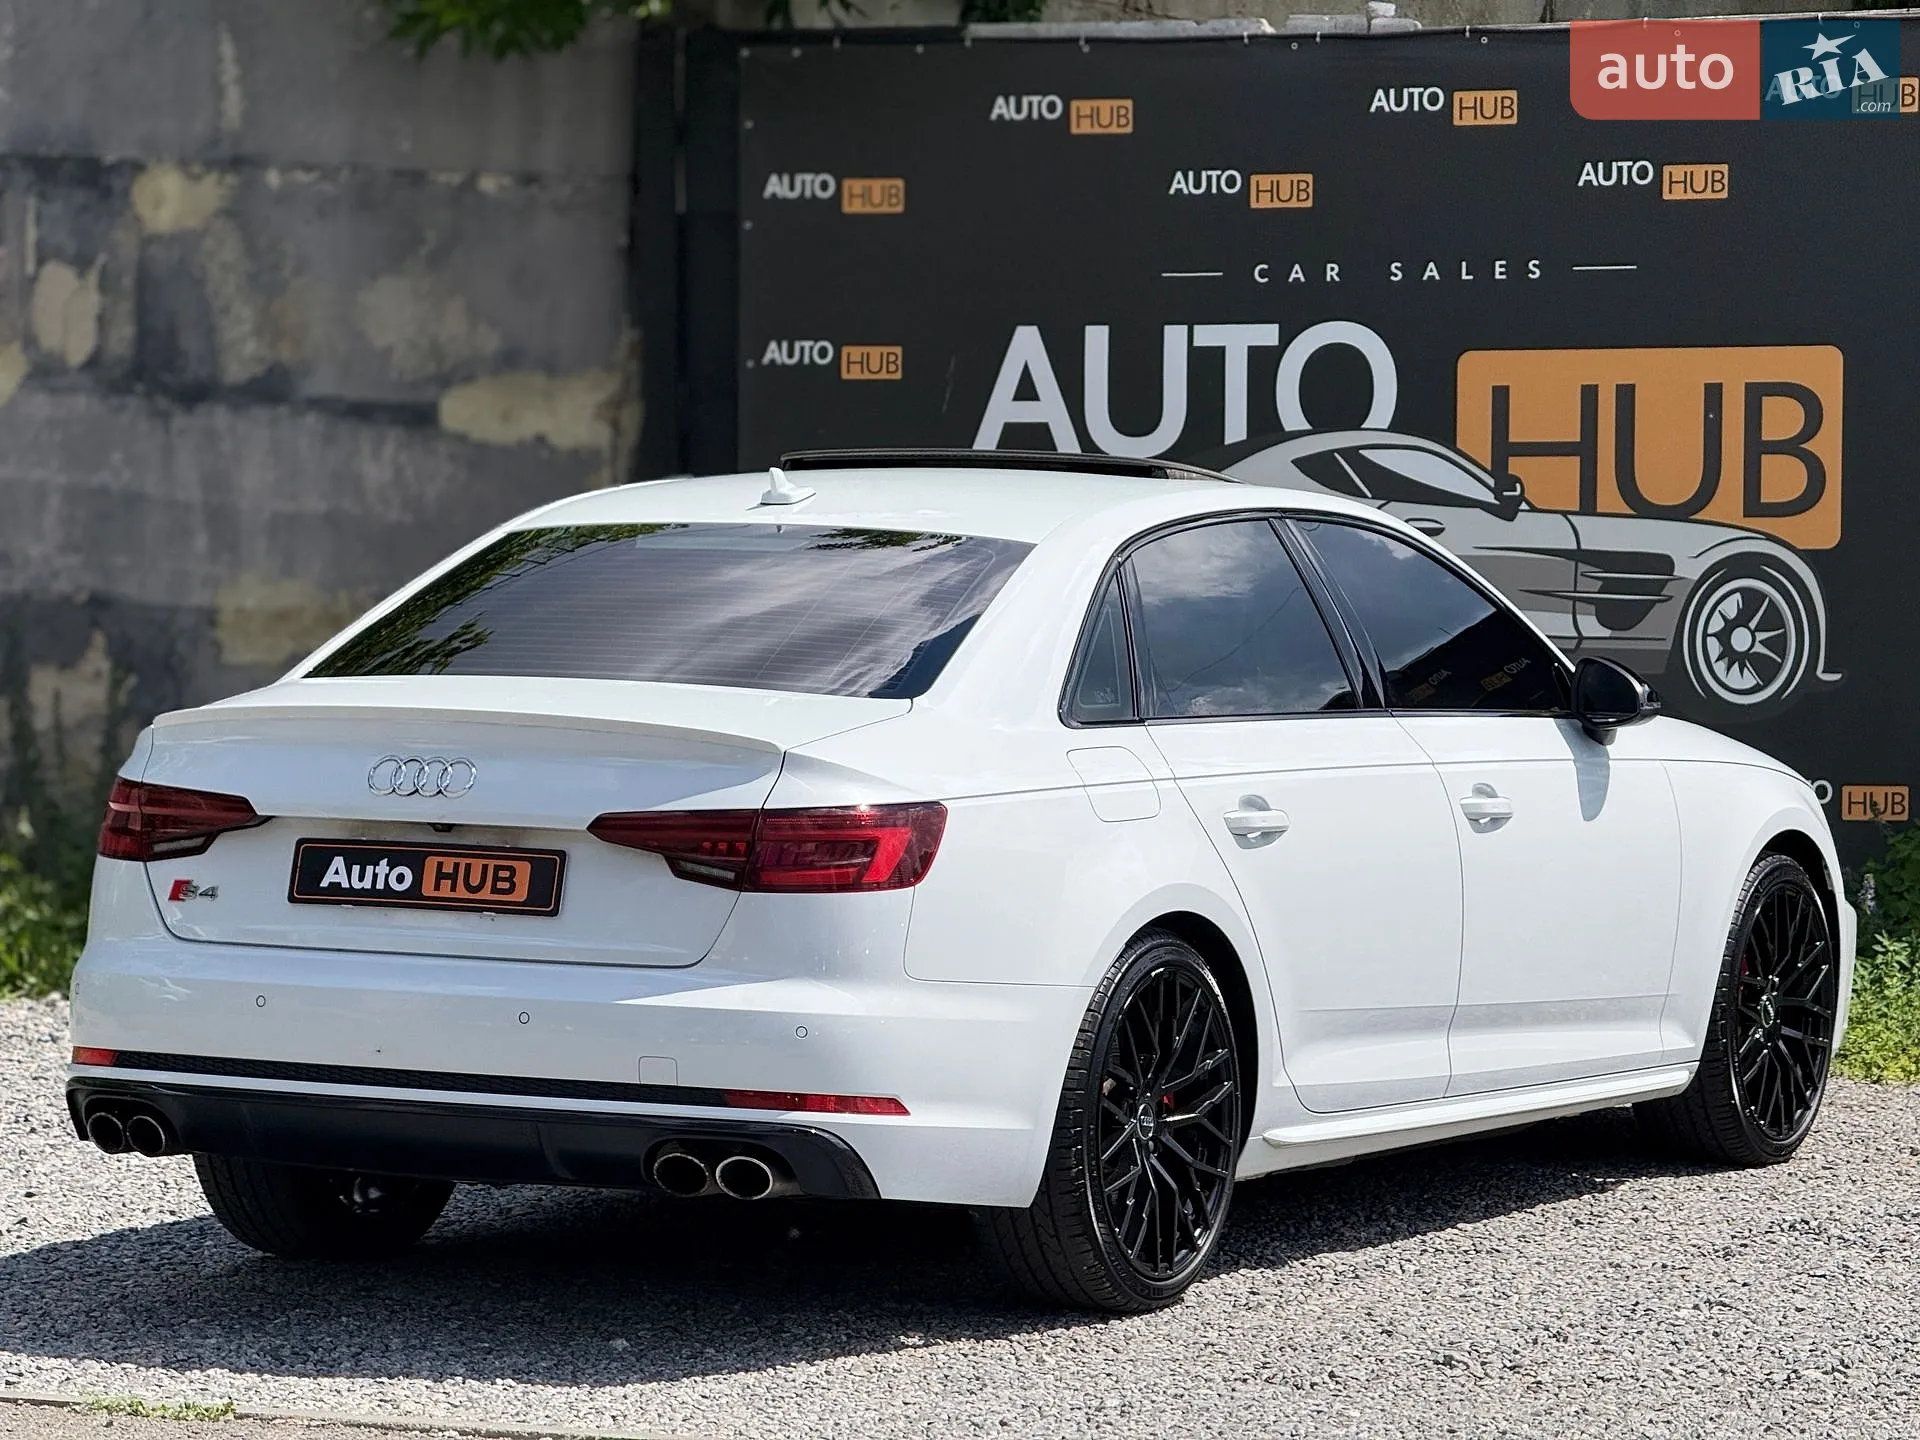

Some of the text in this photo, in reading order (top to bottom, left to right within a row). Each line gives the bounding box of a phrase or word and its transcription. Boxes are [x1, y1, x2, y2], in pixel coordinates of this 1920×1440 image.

[991, 95, 1131, 129] AUTO HUB
[1369, 87, 1515, 120] AUTO HUB
[764, 173, 901, 209] AUTO HUB
[1169, 170, 1310, 204] AUTO HUB
[1578, 161, 1725, 195] AUTO HUB
[1254, 260, 1541, 284] CAR SALES
[762, 341, 900, 375] AUTO HUB
[973, 320, 1826, 519] AUTO HUB
[1847, 791, 1906, 816] HUB
[319, 856, 516, 896] Auto HUB
